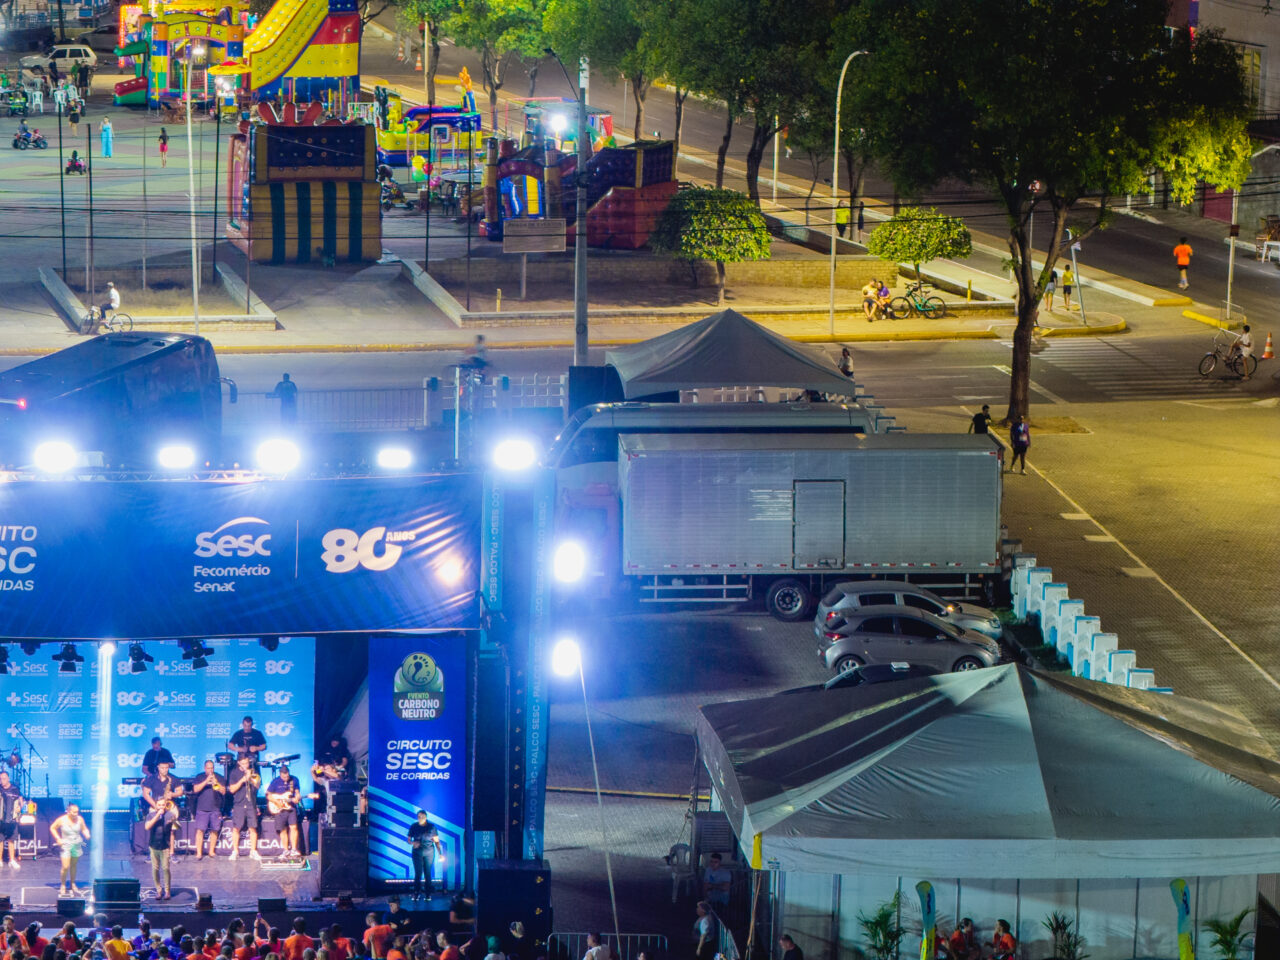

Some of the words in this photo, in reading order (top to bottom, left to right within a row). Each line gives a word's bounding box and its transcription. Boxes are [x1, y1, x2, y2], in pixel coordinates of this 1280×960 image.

[193, 517, 271, 557] Sesc
[386, 531, 416, 542] ANOS
[490, 542, 498, 574] PALCO
[193, 565, 271, 577] Fecomércio
[193, 581, 235, 592] Senac
[23, 661, 48, 673] Sesc
[23, 691, 48, 703] Sesc
[170, 691, 196, 703] Sesc
[398, 699, 440, 709] CARBONO
[402, 708, 436, 718] NEUTRO
[24, 723, 48, 735] Sesc
[171, 722, 197, 734] Sesc
[387, 739, 452, 750] CIRCUITO
[385, 752, 452, 770] SESC
[386, 772, 399, 780] DE
[401, 772, 451, 780] CORRIDAS
[528, 839, 536, 860] ESC
[532, 705, 540, 730] SESC
